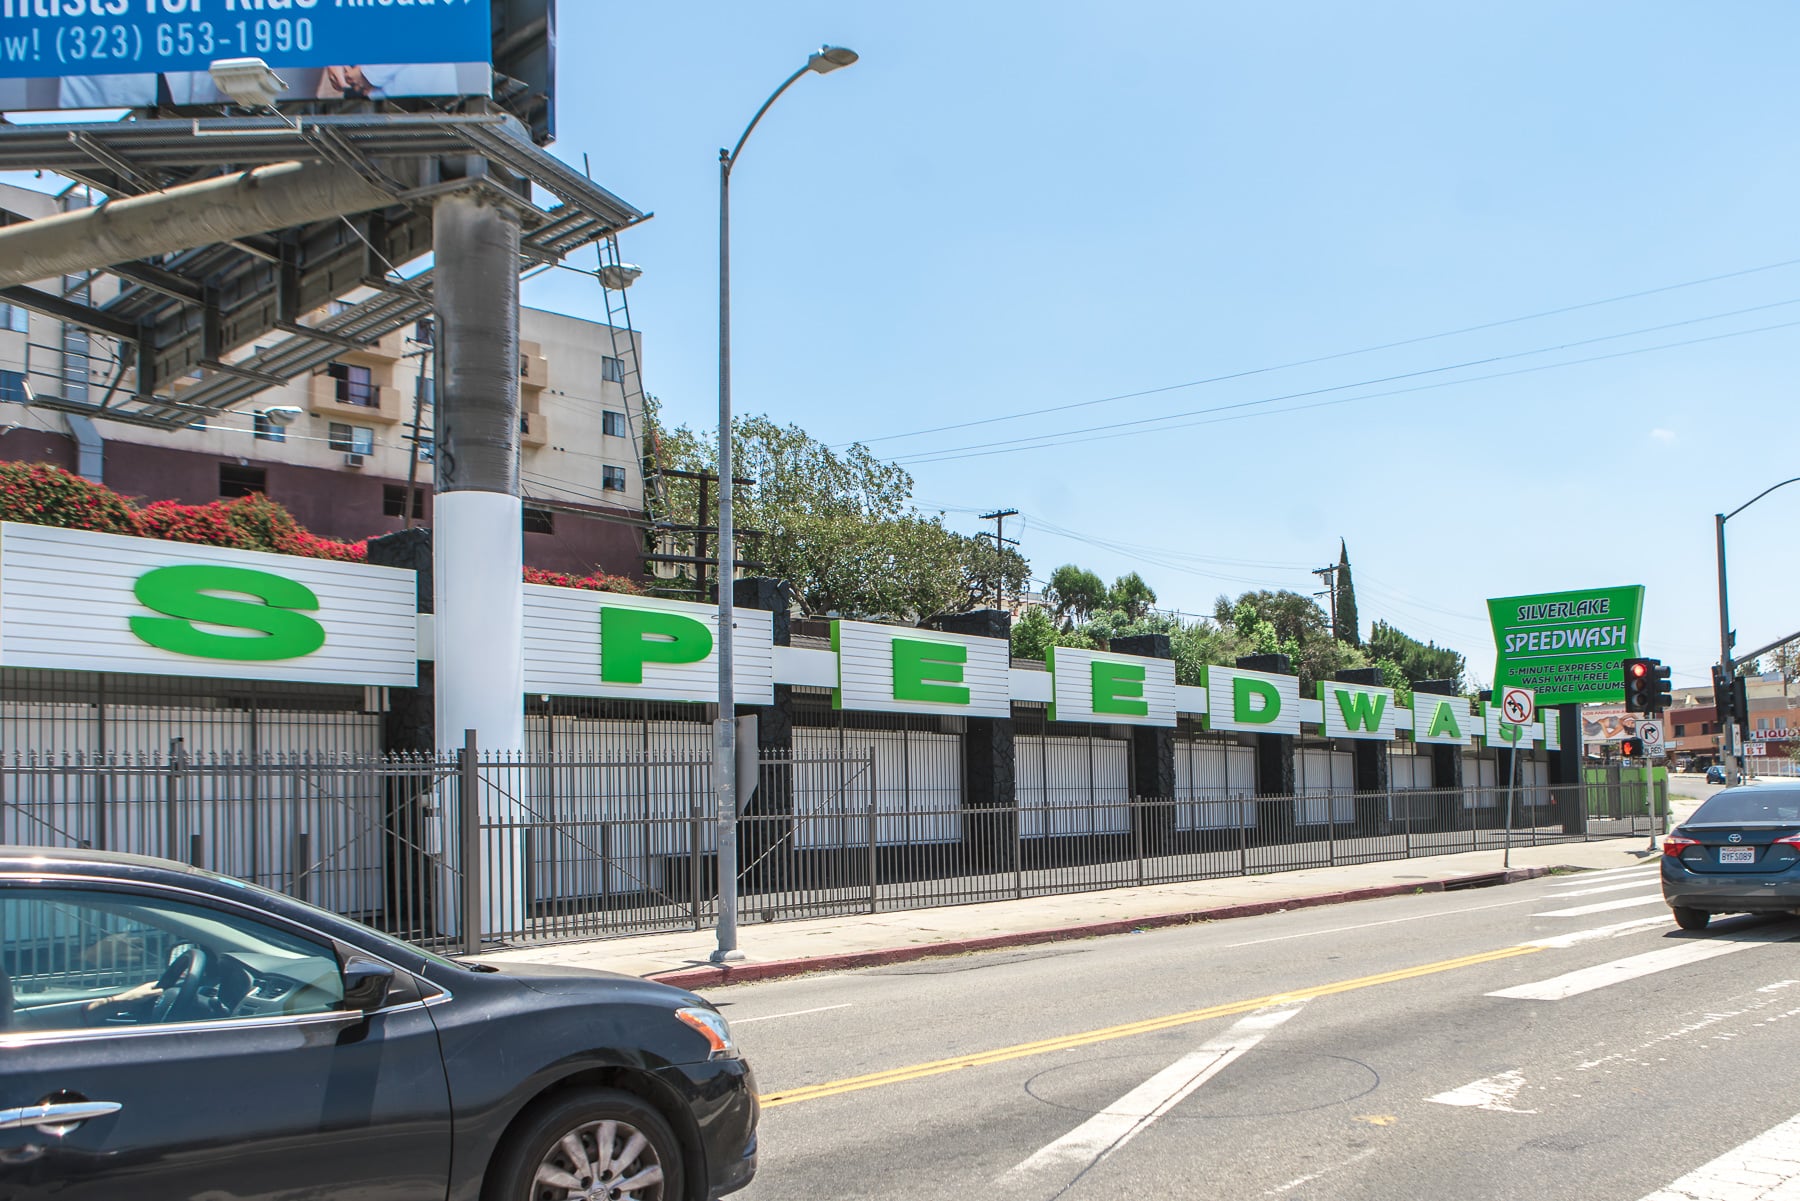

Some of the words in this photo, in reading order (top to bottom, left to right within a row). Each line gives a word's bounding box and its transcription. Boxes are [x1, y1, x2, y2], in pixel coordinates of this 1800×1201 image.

[0, 28, 40, 62] w!
[56, 23, 142, 64] (323)
[156, 17, 314, 57] 653-1990
[1518, 598, 1609, 621] SILVERLAKE
[1505, 625, 1626, 653] SPEEDWASH
[1509, 666, 1555, 675] 5-MINUTE
[1558, 663, 1602, 672] EXPRESS
[1522, 675, 1550, 684] WASH
[1553, 673, 1580, 683] WITH
[1583, 672, 1608, 680] FREE
